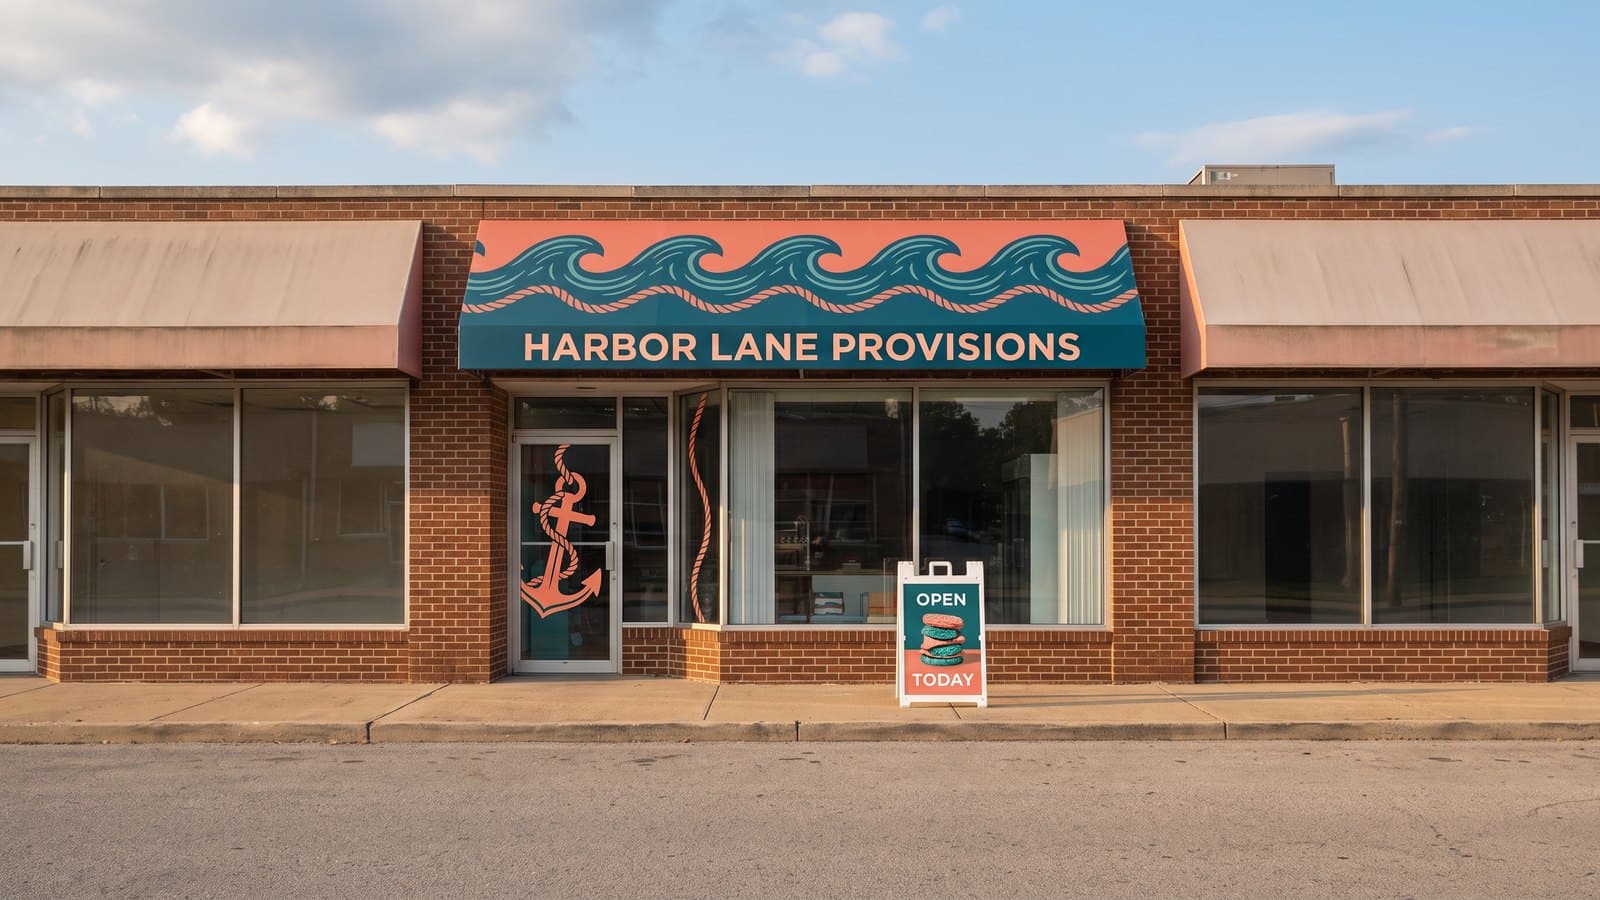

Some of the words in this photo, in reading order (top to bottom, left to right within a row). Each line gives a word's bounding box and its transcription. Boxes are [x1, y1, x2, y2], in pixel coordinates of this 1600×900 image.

[524, 332, 697, 362] HARBOR
[711, 332, 819, 362] LANE
[832, 332, 1081, 362] PROVISIONS
[916, 593, 966, 607] OPEN
[912, 673, 974, 687] TODAY
